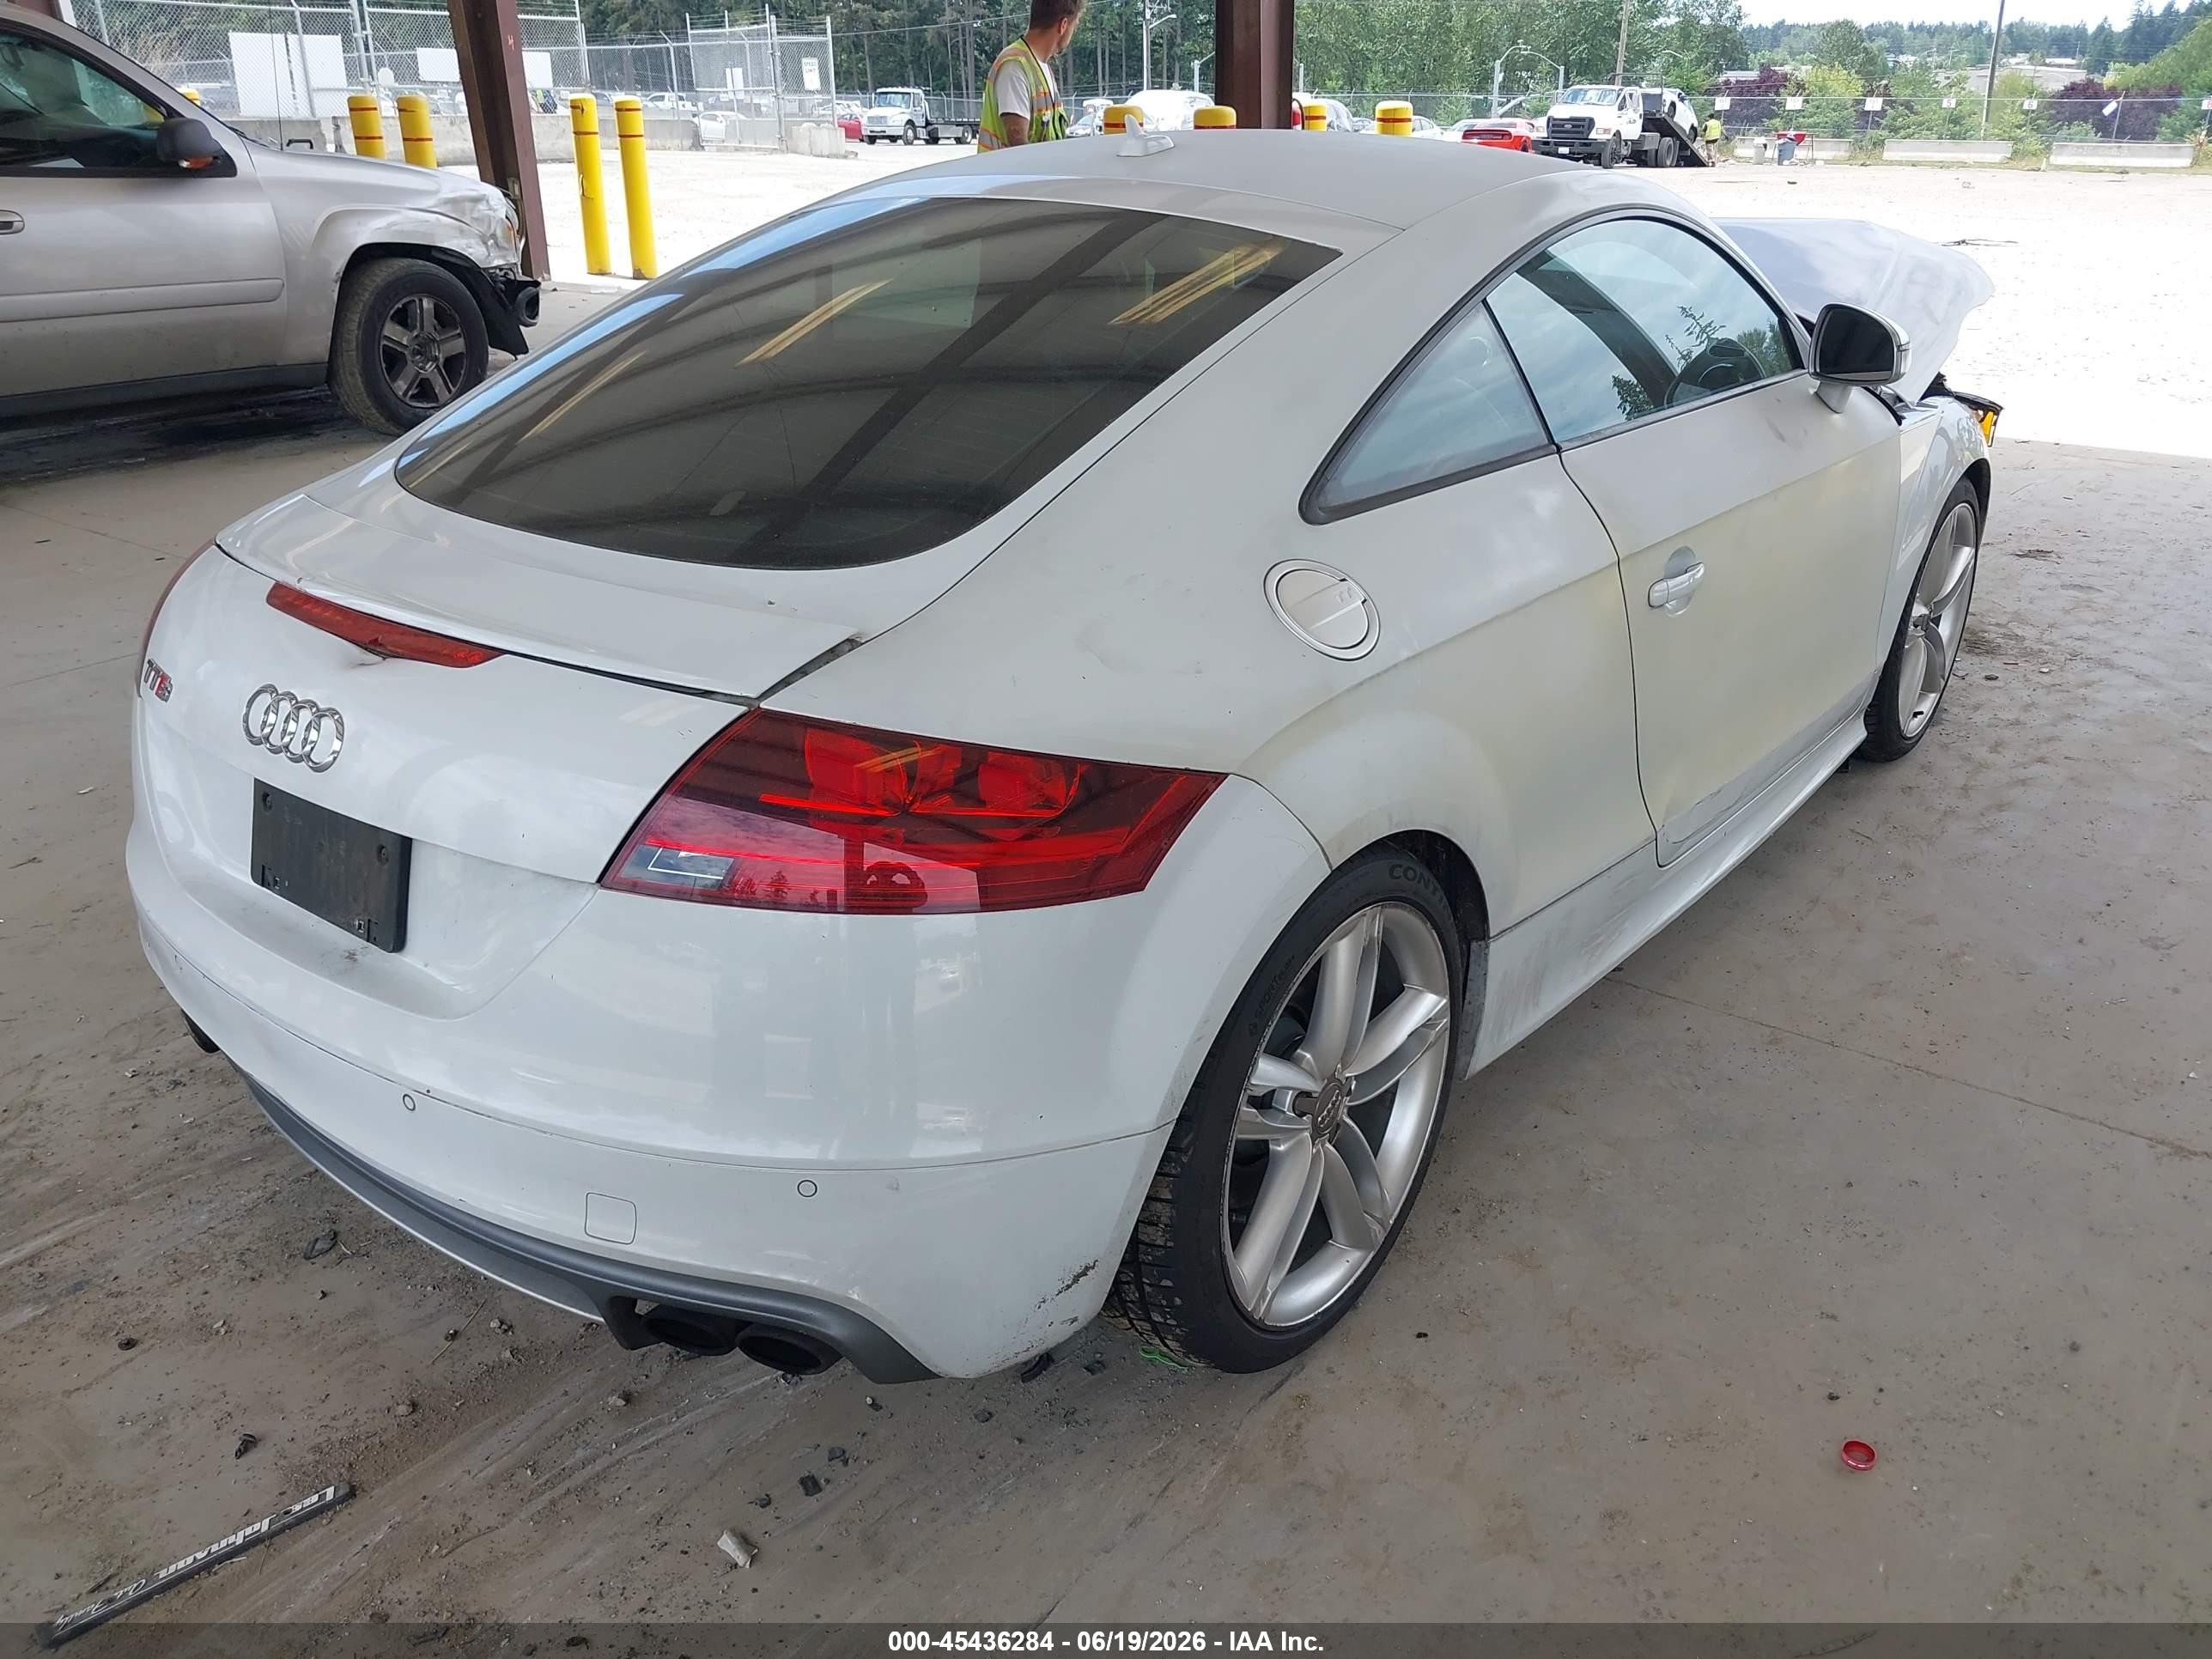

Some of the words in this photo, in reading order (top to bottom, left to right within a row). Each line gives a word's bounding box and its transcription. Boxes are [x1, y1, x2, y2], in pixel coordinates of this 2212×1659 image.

[1947, 99, 1953, 107] 5
[2027, 100, 2034, 109] 6
[143, 658, 173, 702] TTS
[153, 1513, 277, 1579] Johnson
[111, 1578, 147, 1601] Aut
[52, 1599, 109, 1632] Family
